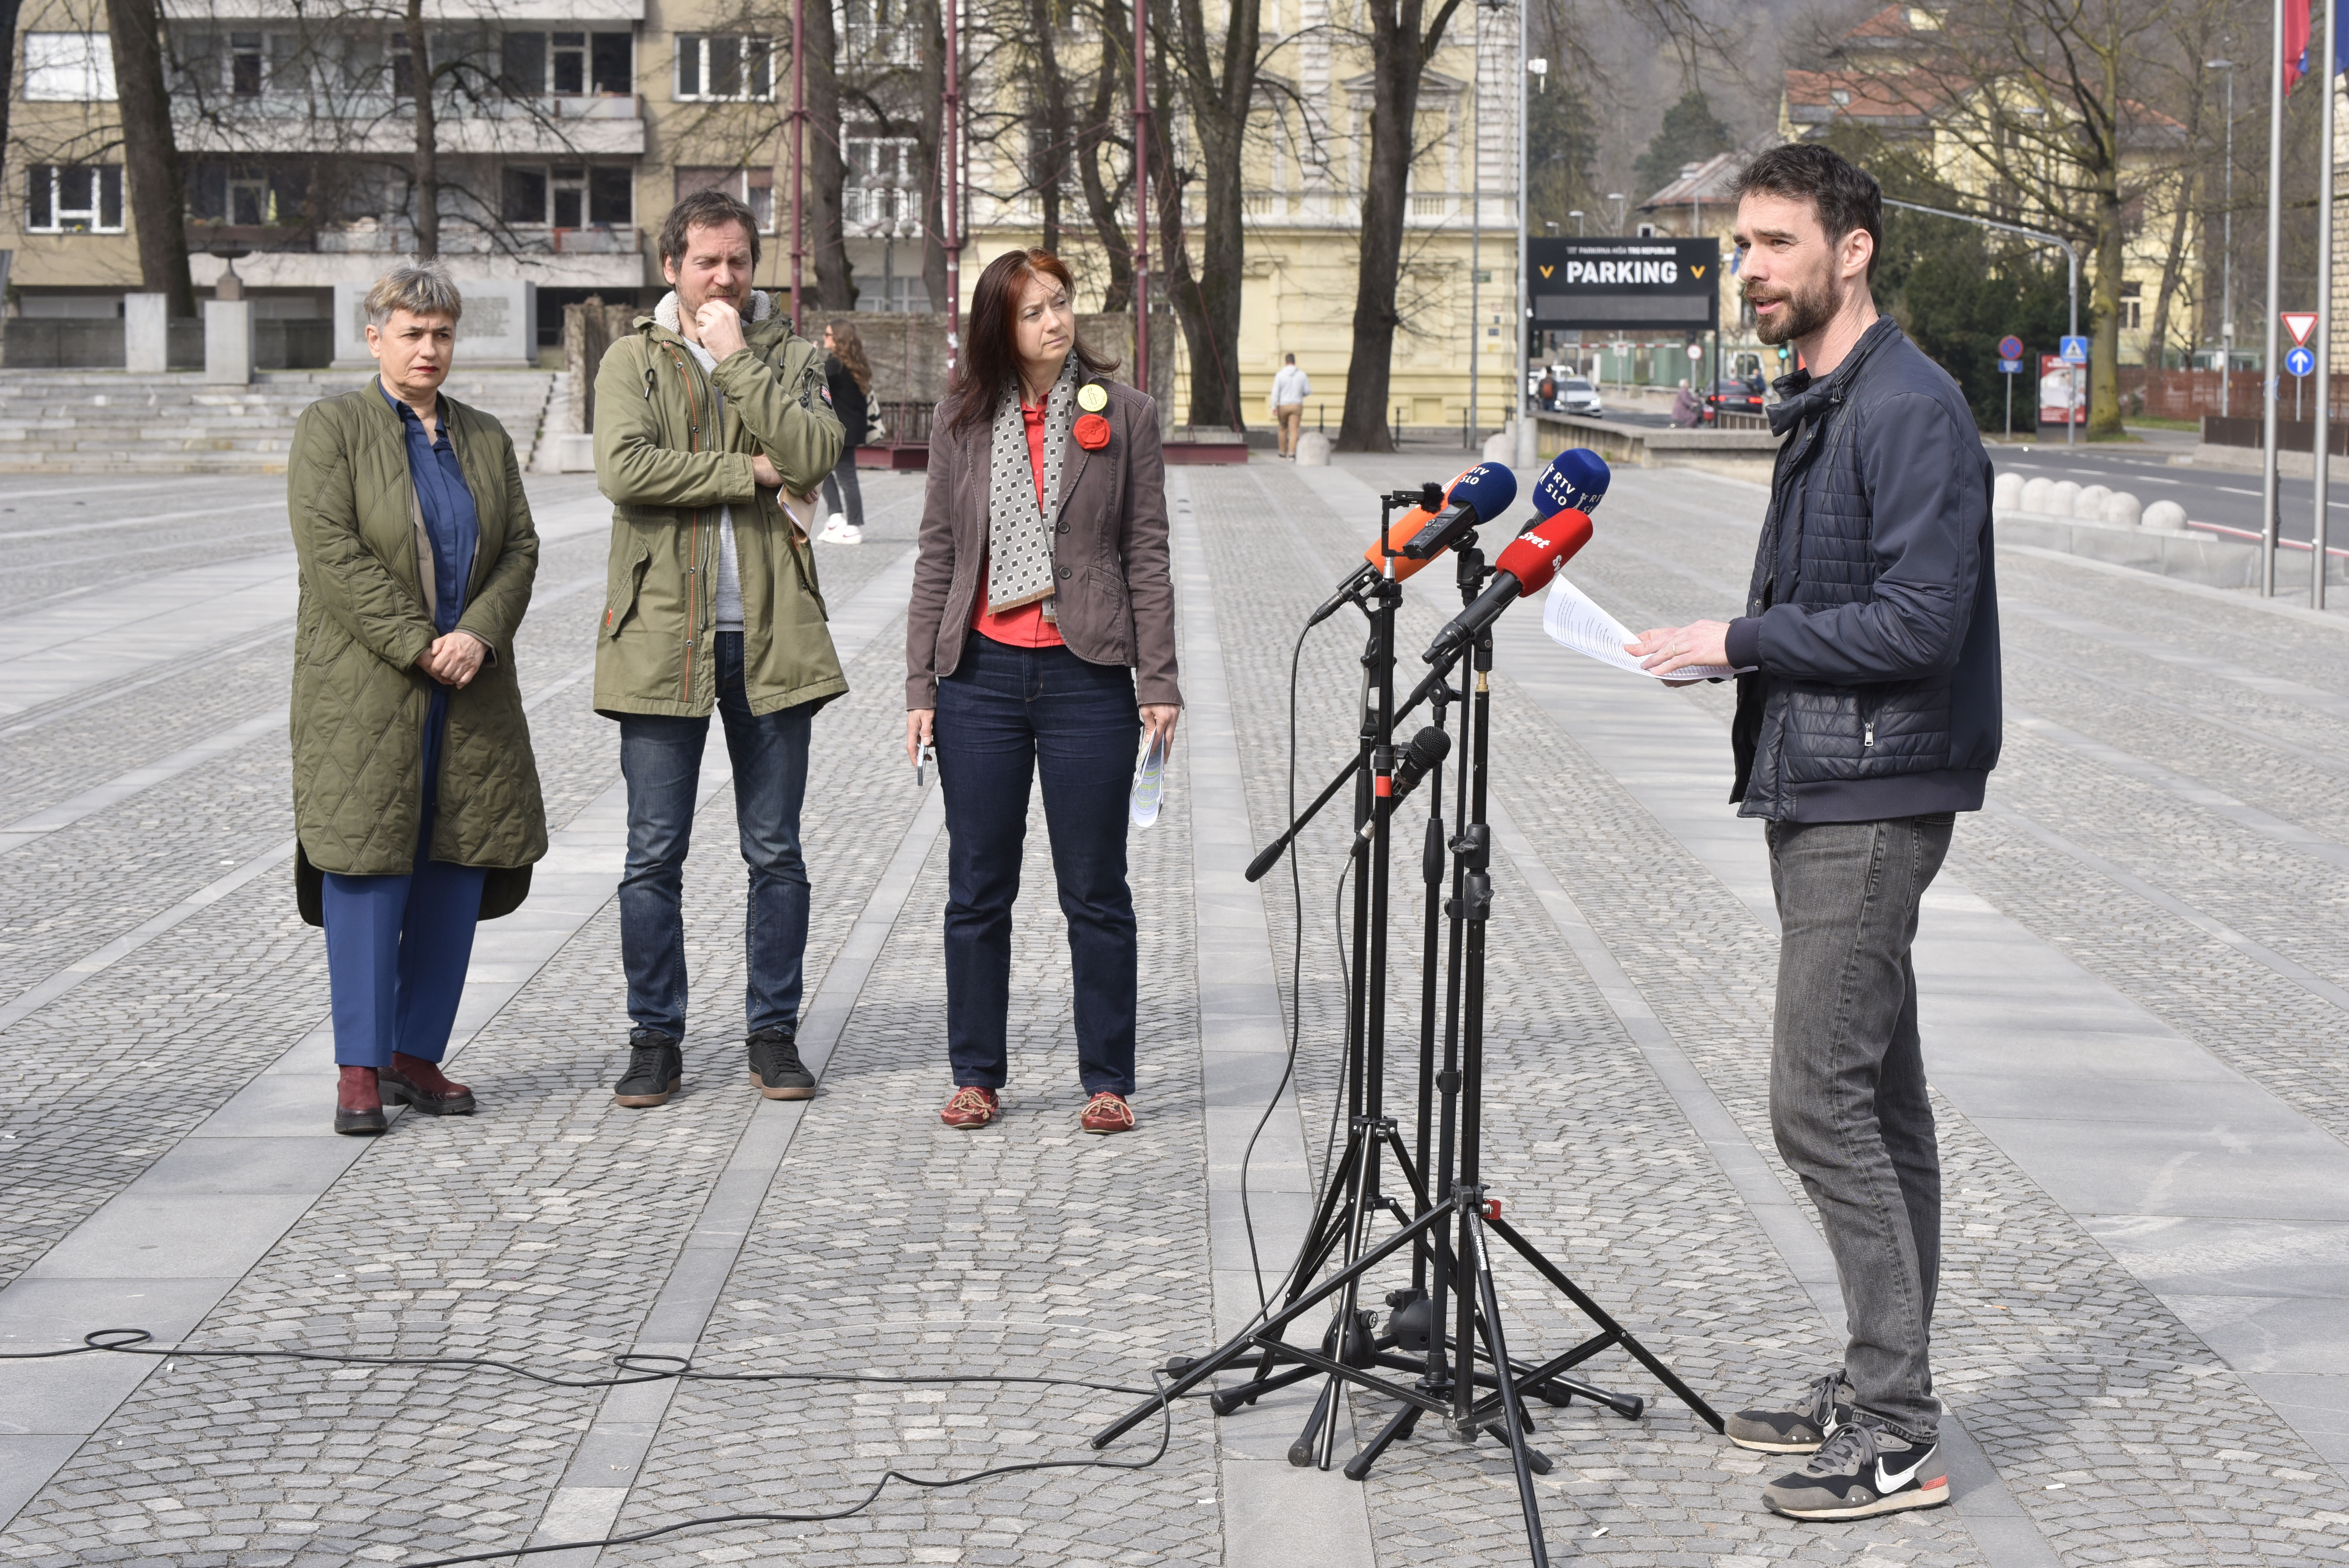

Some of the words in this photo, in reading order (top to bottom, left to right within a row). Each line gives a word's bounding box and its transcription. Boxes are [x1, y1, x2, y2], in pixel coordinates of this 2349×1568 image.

[1567, 261, 1677, 284] PARKING
[1460, 475, 1479, 485] SLO
[1469, 467, 1490, 475] RTV
[1553, 472, 1576, 494] RTV
[1545, 483, 1567, 506] SLO
[1518, 532, 1551, 549] Svet
[1476, 1235, 1488, 1271] Manfrotto
